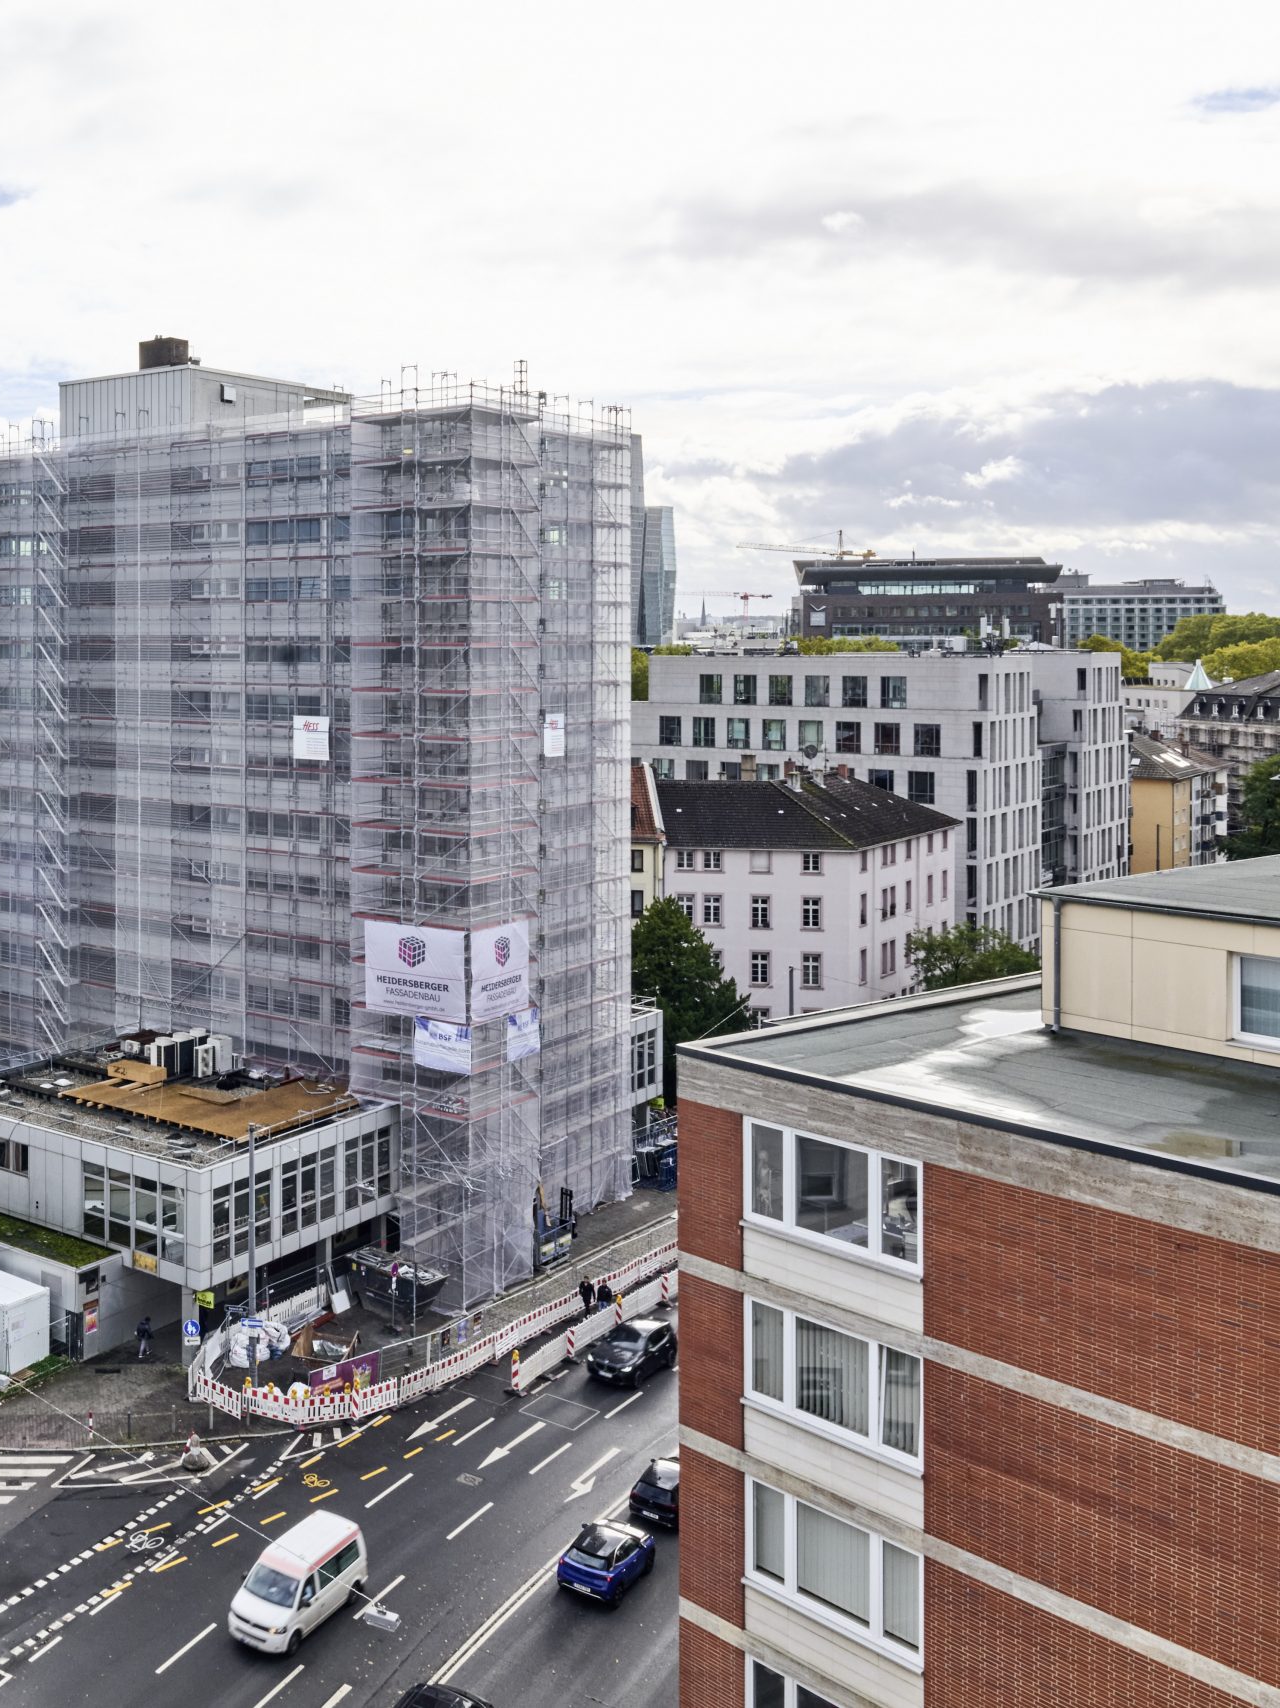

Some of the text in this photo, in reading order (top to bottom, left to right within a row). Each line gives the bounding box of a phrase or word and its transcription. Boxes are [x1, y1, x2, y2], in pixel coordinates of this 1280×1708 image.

[376, 975, 450, 993] HEIDERSBERGER
[481, 974, 522, 993] HEIDERSBERGER
[385, 986, 441, 1003] FASSADENBAU
[438, 1033, 452, 1042] BSF
